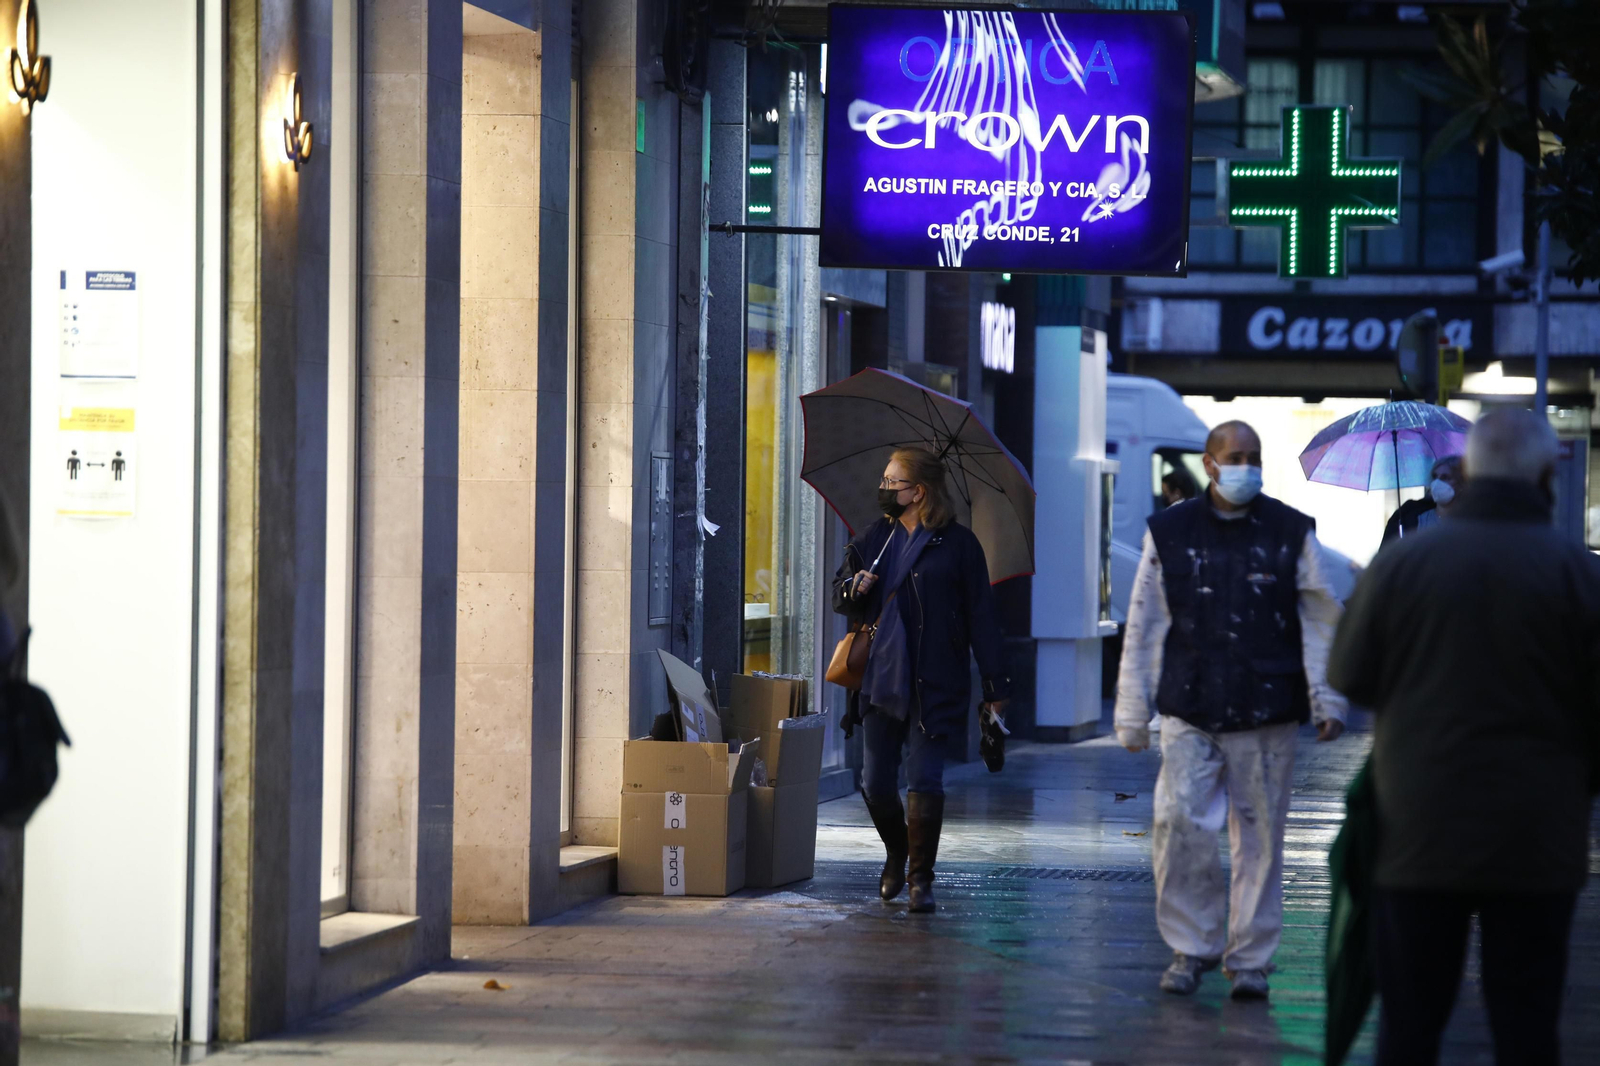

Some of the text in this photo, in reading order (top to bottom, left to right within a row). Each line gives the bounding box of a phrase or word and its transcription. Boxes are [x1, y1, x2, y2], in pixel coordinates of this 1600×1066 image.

[865, 109, 1150, 154] crown
[863, 177, 1147, 201] AGUSTIN FRAGERO Y CIA, S. L.
[927, 224, 1080, 244] CRUZ CONDE, 21
[1247, 306, 1472, 350] Cazora
